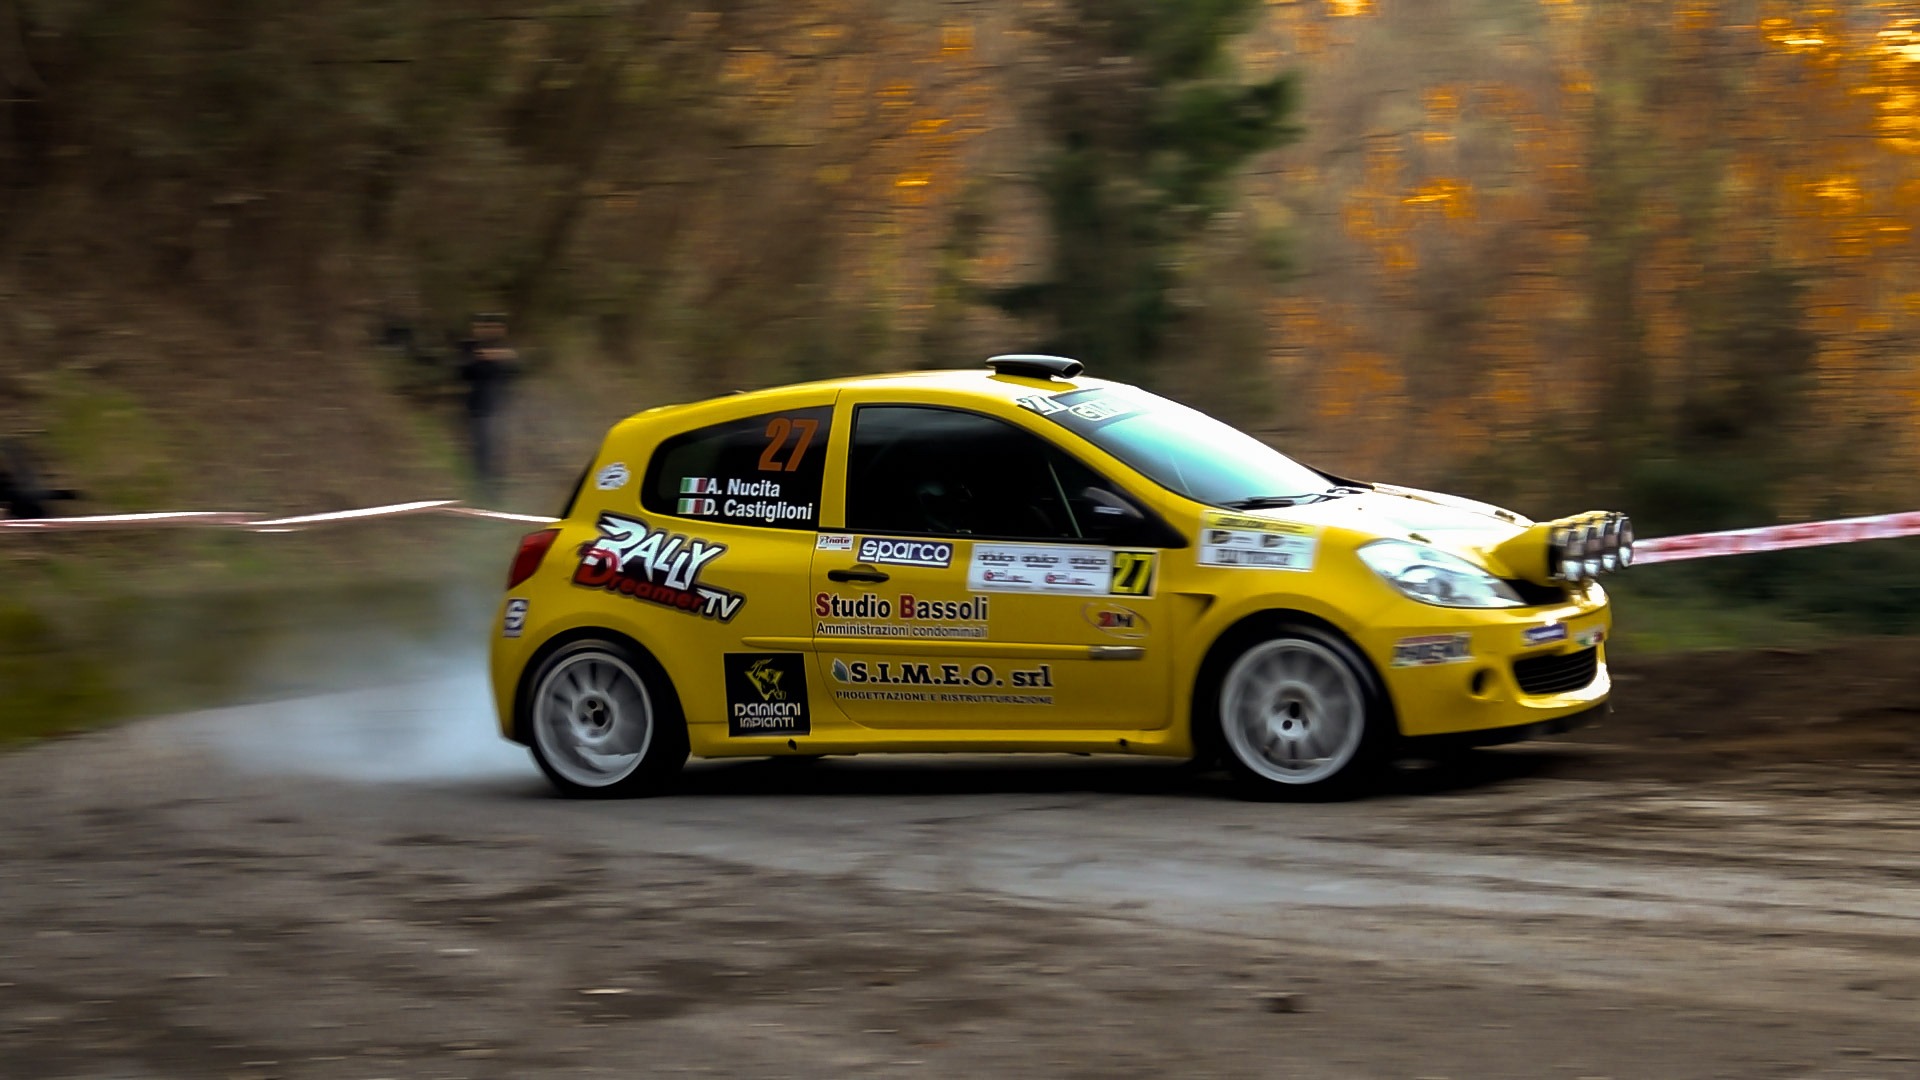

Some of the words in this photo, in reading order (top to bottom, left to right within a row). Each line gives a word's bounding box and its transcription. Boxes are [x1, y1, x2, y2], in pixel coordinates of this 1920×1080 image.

[758, 418, 819, 471] 27
[706, 478, 722, 494] A.
[728, 479, 780, 497] Nucita
[704, 499, 718, 515] D.
[724, 499, 812, 522] Castiglioni
[594, 516, 723, 590] RALLY
[862, 539, 950, 563] sparco
[1112, 552, 1154, 594] 27
[697, 588, 741, 618] TV
[816, 593, 891, 618] Studio
[900, 595, 987, 620] Bassoli
[816, 622, 908, 637] Amministrazioni
[913, 626, 987, 638] condominiali
[851, 662, 1003, 687] S.I.M.E.O.
[1013, 665, 1053, 688] srl
[734, 702, 801, 717] DAMIANI
[836, 690, 927, 701] PROGETTAZIONE
[941, 692, 1053, 705] RISTRUTTURAZIONE
[740, 717, 794, 728] IMPIANTI
